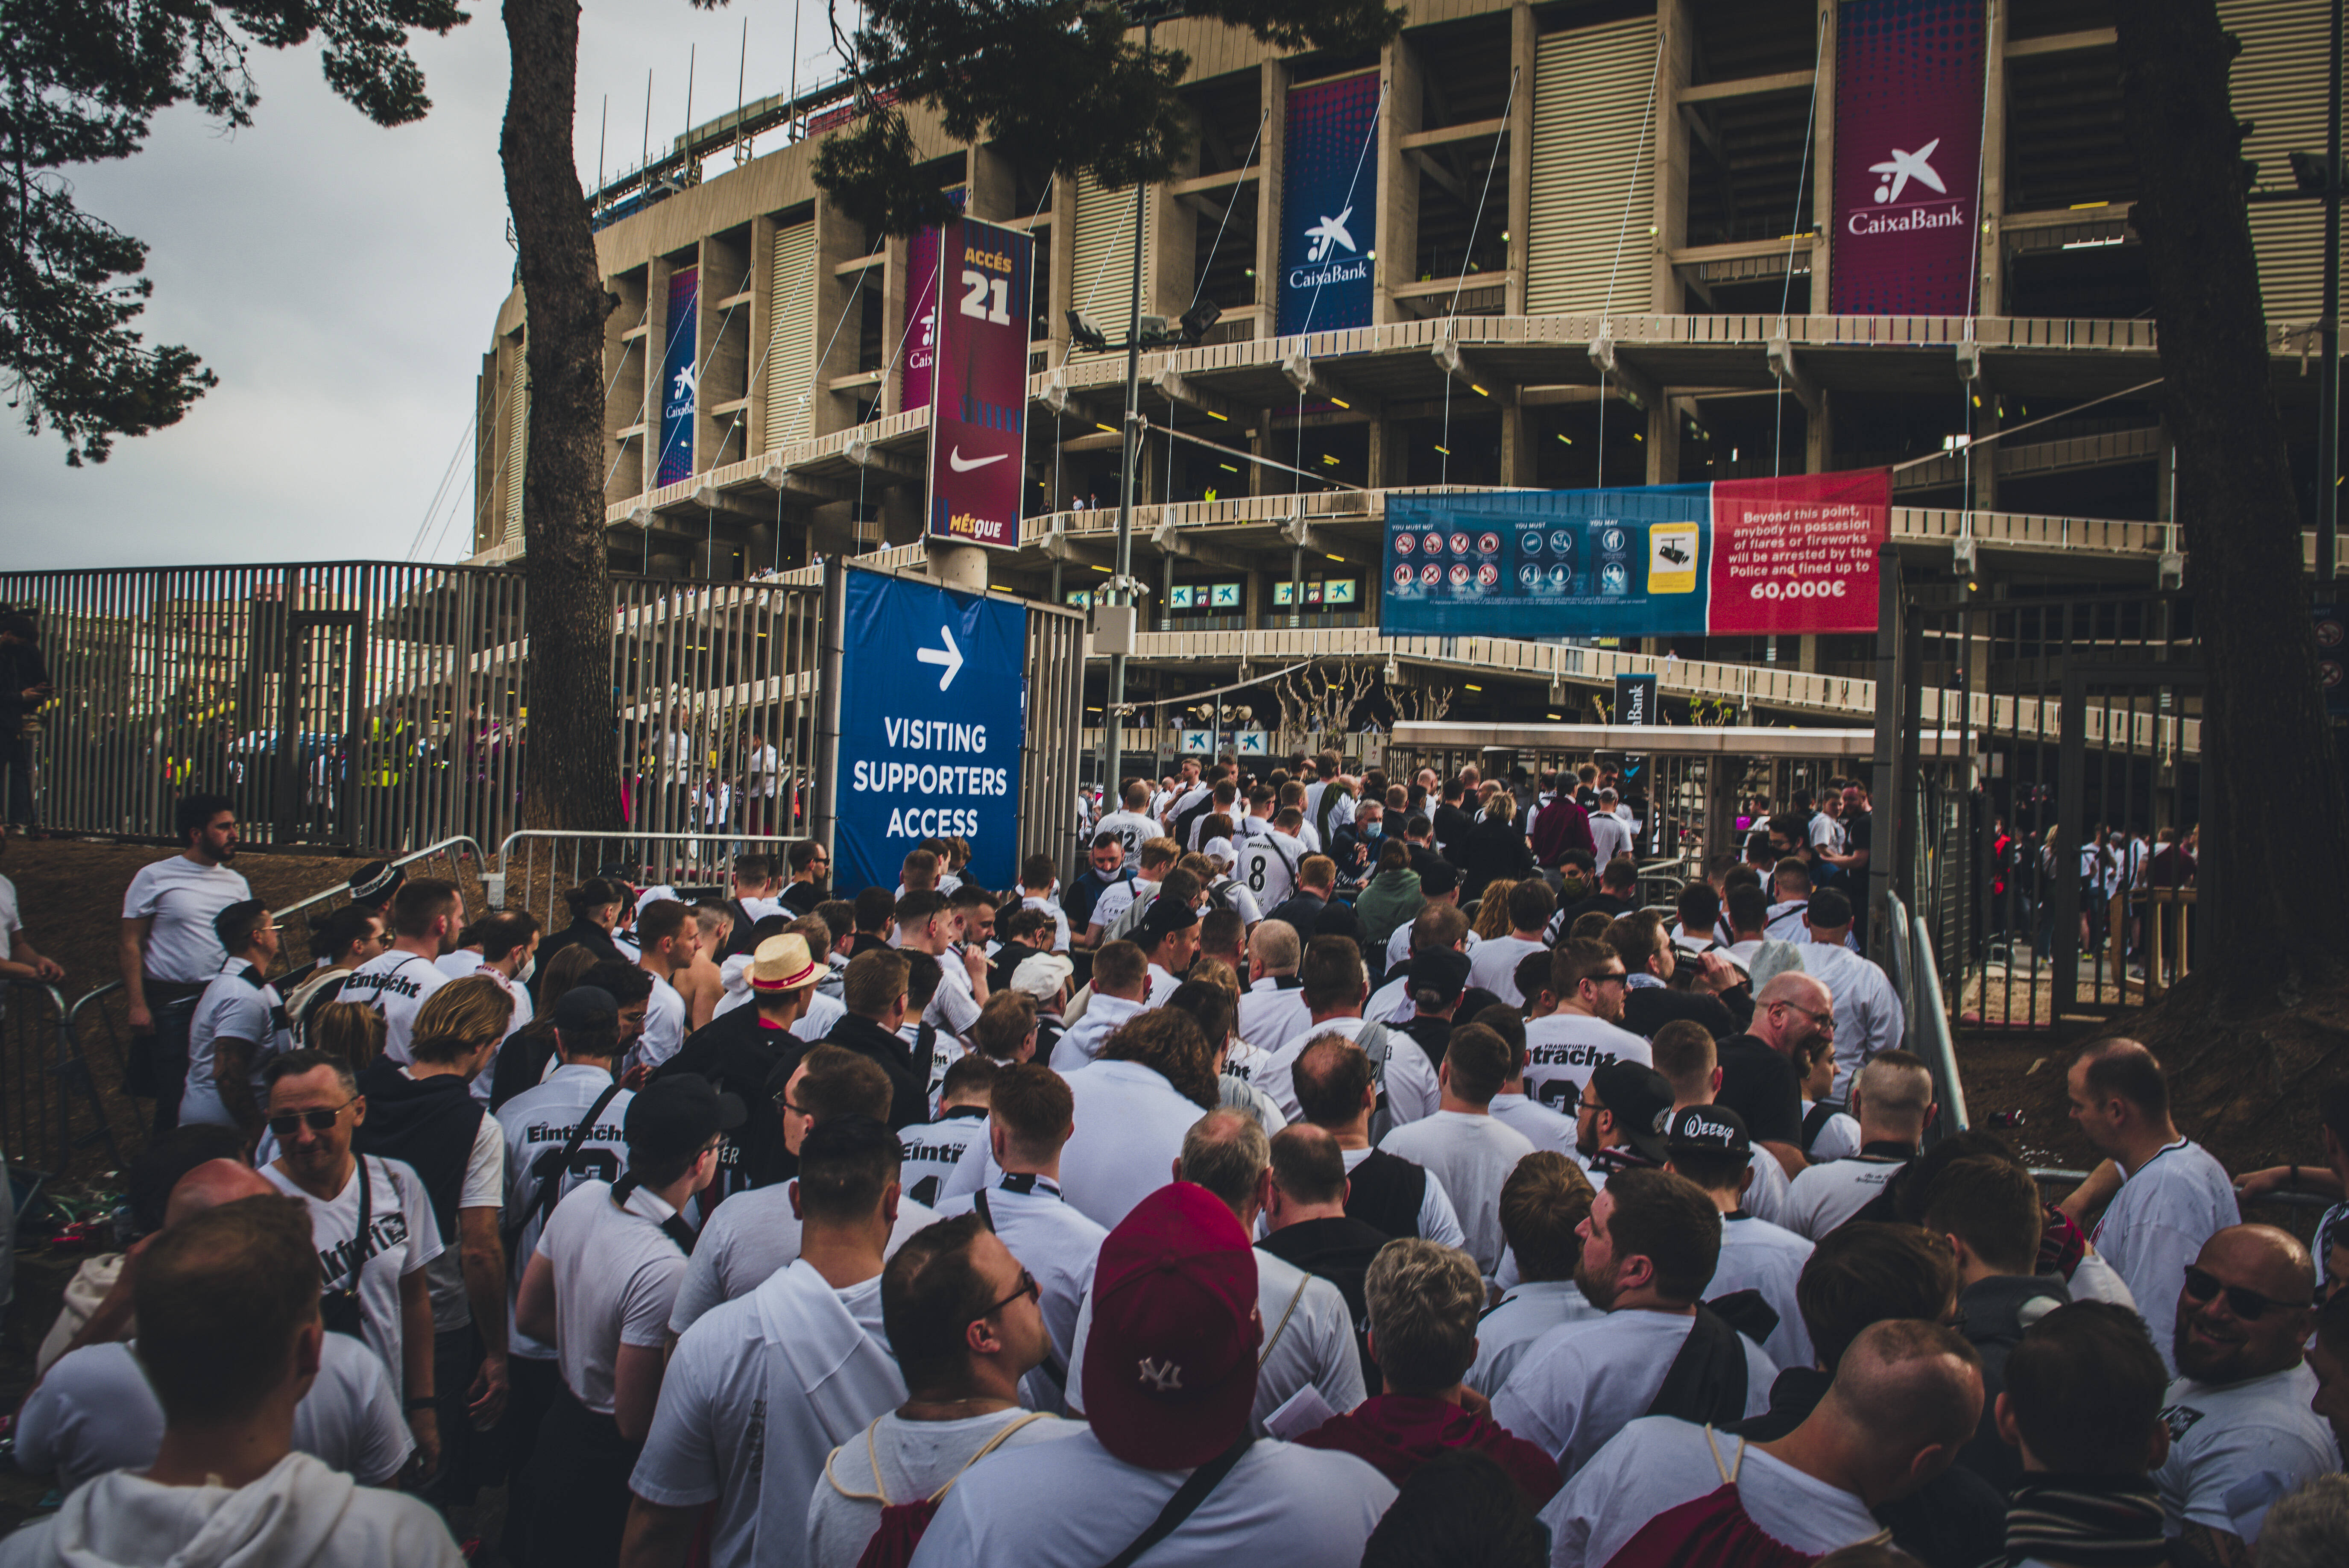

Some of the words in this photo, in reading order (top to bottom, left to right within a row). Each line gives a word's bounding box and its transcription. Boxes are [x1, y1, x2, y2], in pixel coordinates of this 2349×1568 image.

[1848, 205, 1964, 235] CaixaBank
[964, 246, 1012, 273] ACCÉS
[1290, 261, 1367, 289] CaixaBank
[960, 270, 1011, 326] 21
[1744, 510, 1790, 525] Beyond
[1795, 508, 1818, 520] this
[1822, 504, 1860, 520] point,
[1734, 523, 1785, 538] anybody
[1790, 522, 1801, 533] in
[1805, 519, 1870, 533] possesion
[1734, 540, 1746, 551] of
[1751, 537, 1785, 549] flares
[1789, 538, 1803, 547] or
[1807, 533, 1867, 546] fireworks
[1729, 552, 1749, 564] will
[1753, 551, 1767, 563] be
[1772, 548, 1826, 562] arrested
[1830, 548, 1846, 560] by
[1851, 546, 1872, 558] the
[1730, 564, 1768, 577] Police
[1772, 563, 1794, 575] and
[1798, 562, 1831, 574] fined
[1836, 563, 1851, 574] up
[1856, 560, 1870, 572] to
[1751, 580, 1846, 601] 60,000€
[885, 716, 987, 753] VISITING
[853, 760, 1007, 796] SUPPORTERS
[886, 807, 978, 838] ACCESS
[1248, 856, 1266, 892] 8
